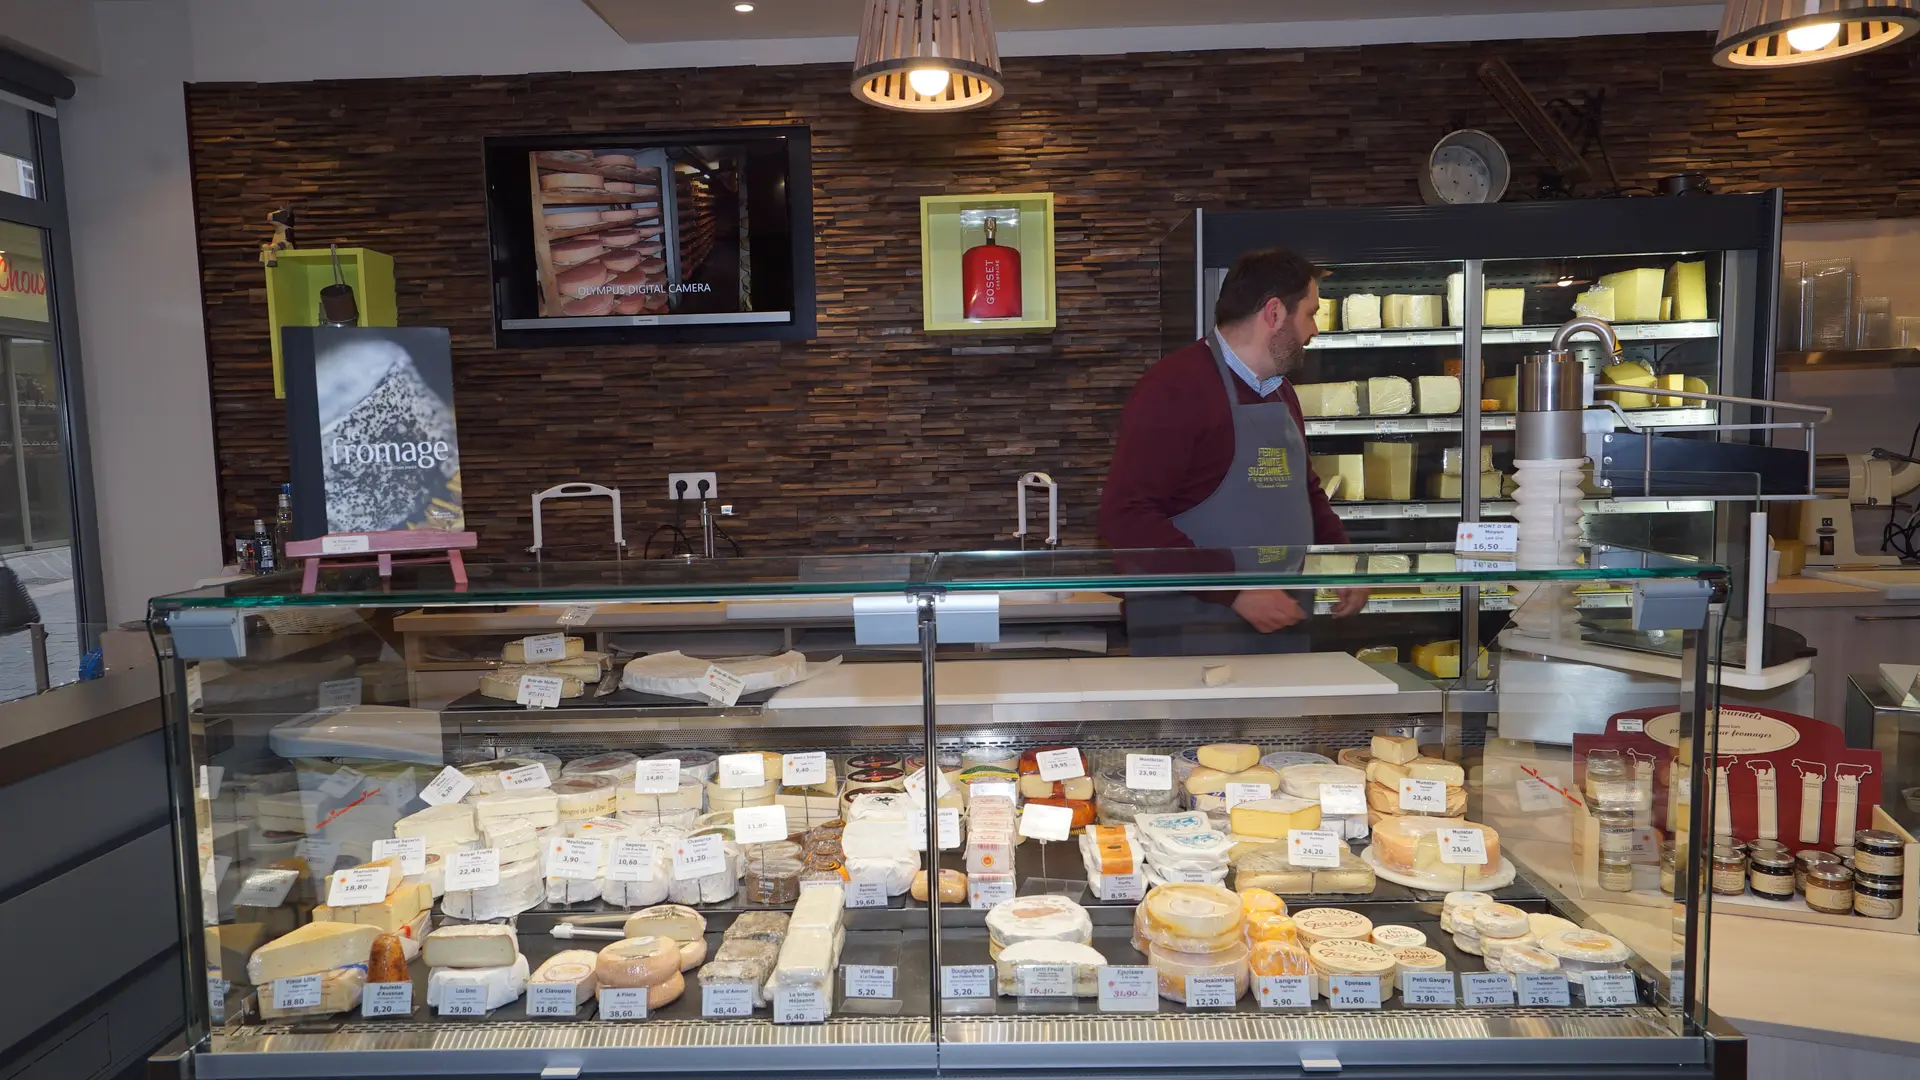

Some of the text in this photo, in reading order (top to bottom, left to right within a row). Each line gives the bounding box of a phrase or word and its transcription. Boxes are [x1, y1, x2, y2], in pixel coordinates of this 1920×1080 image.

[985, 260, 995, 305] GOSSET
[578, 283, 711, 296] OLYMPUS DIGITAL CAMERA
[346, 427, 360, 441] le
[331, 437, 449, 469] fromage
[1473, 543, 1499, 551] 16,50
[1731, 729, 1772, 739] fromages
[1412, 794, 1432, 802] 23,40
[1303, 848, 1324, 856] 24,20
[1452, 846, 1471, 854] 23,40
[563, 856, 579, 864] 3,90
[618, 859, 638, 867] 10,60
[686, 855, 706, 863] 11,20
[857, 988, 876, 997] 5,20
[953, 988, 972, 996] 5,20
[282, 998, 305, 1007] 18,80
[1195, 998, 1220, 1006] 12,20
[1272, 998, 1292, 1006] 5,90
[1339, 996, 1365, 1004] 11,60
[1416, 995, 1435, 1003] 3,90
[1475, 996, 1495, 1004] 3,70
[1531, 996, 1549, 1004] 2,85
[1598, 995, 1617, 1003] 5,40
[373, 1005, 392, 1014] 8,20
[449, 1006, 472, 1014] 29,80
[536, 1006, 558, 1014] 11,80
[713, 1007, 737, 1015] 48,40
[609, 1010, 633, 1018] 38,60
[786, 1013, 805, 1021] 6,40
